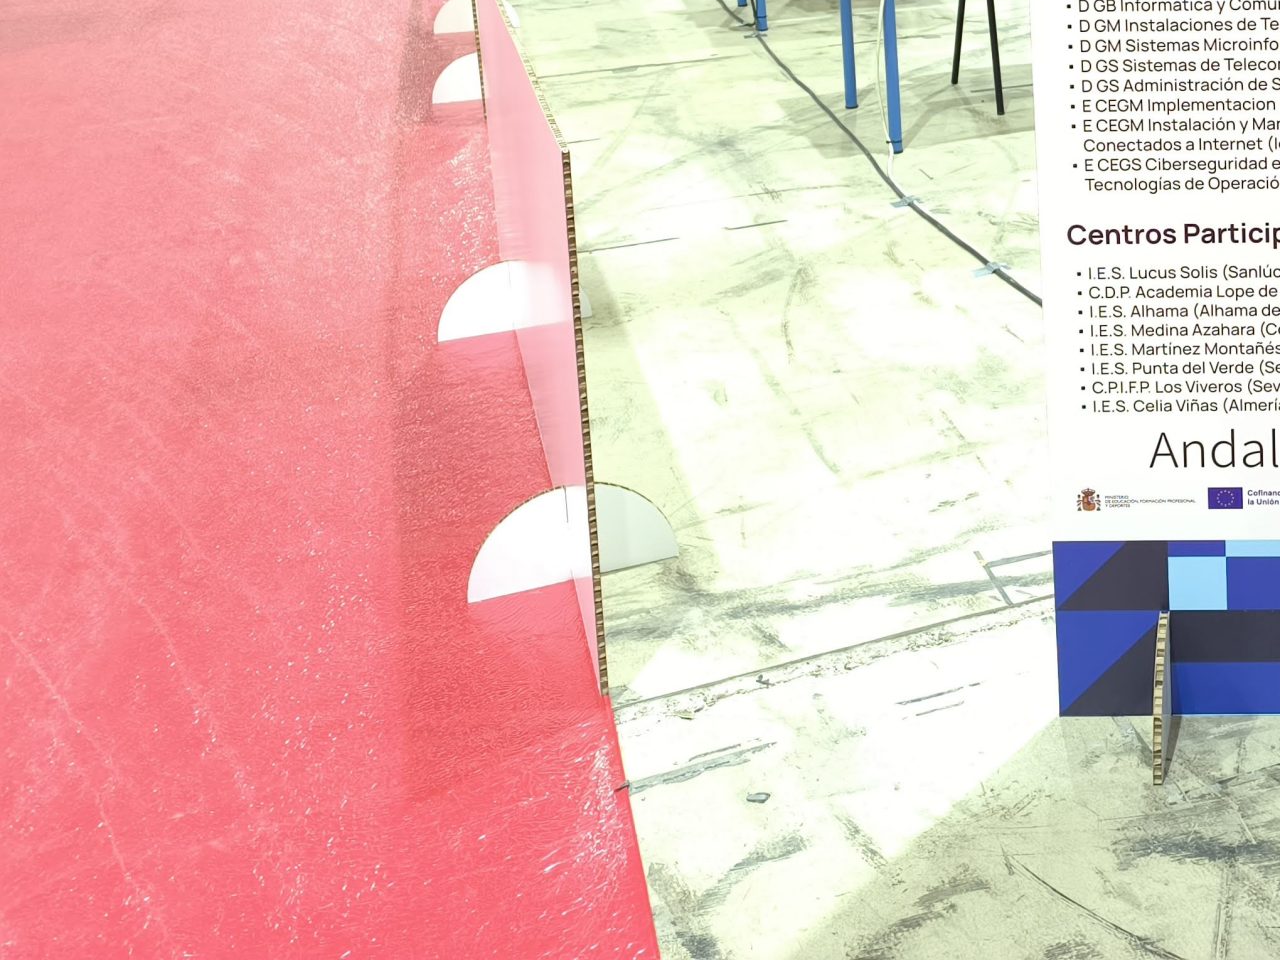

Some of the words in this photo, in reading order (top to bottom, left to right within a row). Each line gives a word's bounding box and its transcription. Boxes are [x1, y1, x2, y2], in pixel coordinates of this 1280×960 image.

[1079, 0, 1089, 12] D
[1093, 0, 1117, 12] GB
[1216, 1, 1226, 15] y
[1079, 19, 1090, 33] D
[1094, 19, 1121, 33] GM
[1125, 18, 1233, 32] Instalaciones
[1237, 18, 1257, 31] de
[1080, 39, 1091, 53] D
[1095, 39, 1121, 53] GM
[1126, 39, 1200, 52] Sistemas
[1081, 60, 1092, 73] D
[1096, 59, 1119, 73] GS
[1123, 59, 1197, 72] Sistemas
[1200, 58, 1220, 72] de
[1082, 80, 1093, 93] D
[1096, 79, 1119, 93] GS
[1123, 77, 1244, 92] Administración
[1248, 78, 1268, 91] de
[1082, 99, 1091, 113] E
[1095, 99, 1143, 113] CEGM
[1148, 98, 1276, 115] Implementacion
[1083, 119, 1092, 132] E
[1096, 119, 1144, 132] CEGM
[1148, 117, 1236, 132] Instalación
[1239, 120, 1248, 134] y
[1083, 138, 1182, 152] Conectados
[1185, 140, 1194, 151] a
[1199, 138, 1263, 151] Internet
[1085, 158, 1094, 172] E
[1097, 158, 1142, 172] CEGS
[1145, 157, 1267, 174] Ciberseguridad
[1084, 177, 1181, 195] Tecnologías
[1185, 177, 1204, 190] de
[1067, 224, 1176, 245] Centros
[1089, 267, 1125, 280] I.E.S.
[1130, 267, 1176, 279] Lucus
[1180, 266, 1218, 279] Solis
[1089, 286, 1130, 299] C.D.P.
[1135, 285, 1212, 299] Academia
[1217, 285, 1255, 301] Lope
[1258, 285, 1278, 297] de
[1090, 305, 1126, 318] I.E.S.
[1130, 305, 1188, 317] Alhama
[1194, 303, 1257, 319] (Alhama
[1261, 304, 1280, 317] de
[1091, 324, 1126, 337] I.E.S.
[1131, 324, 1188, 337] Medina
[1192, 323, 1255, 336] Azahara
[1091, 343, 1127, 356] I.E.S.
[1132, 342, 1200, 356] Martínez
[1092, 362, 1128, 375] I.E.S.
[1132, 362, 1178, 375] Punta
[1182, 361, 1205, 374] del
[1209, 361, 1254, 374] Verde
[1092, 381, 1150, 394] C.P.I.F.P.
[1155, 381, 1182, 393] Los
[1185, 380, 1242, 393] Viveros
[1093, 400, 1129, 413] I.E.S.
[1133, 399, 1172, 412] Celia
[1176, 399, 1218, 412] Viñas
